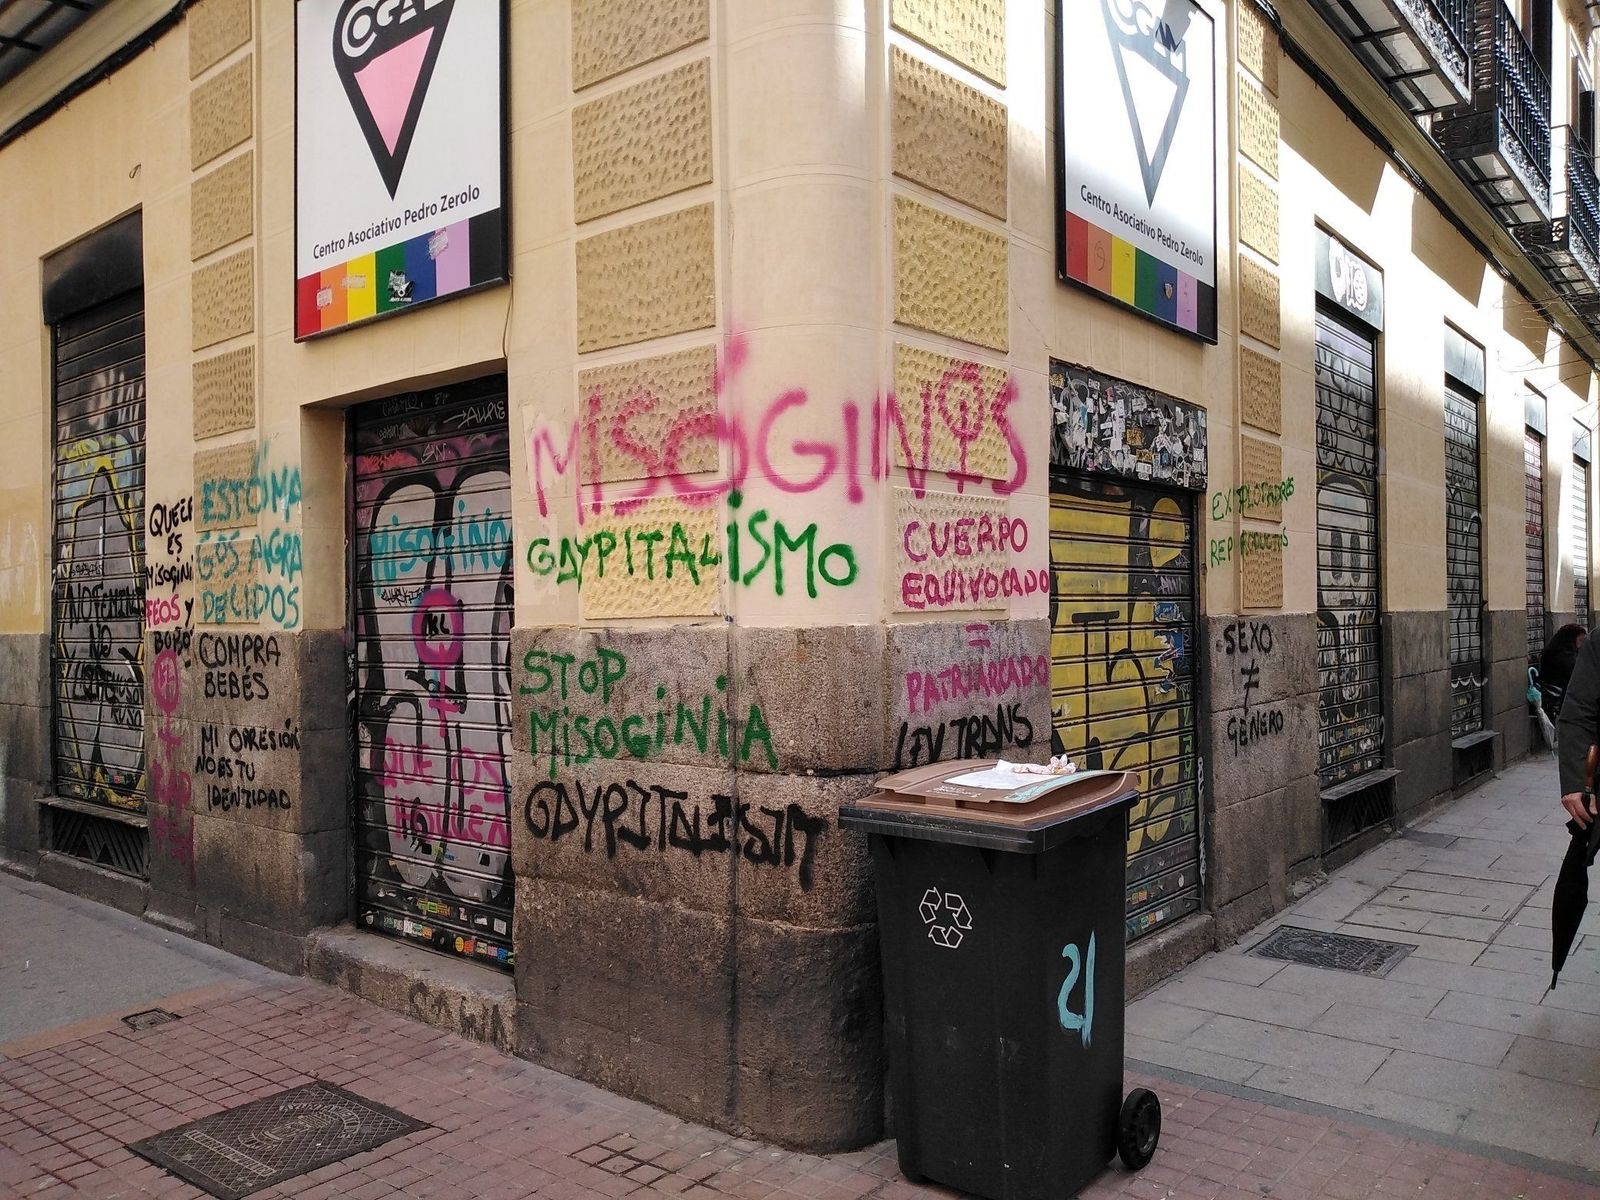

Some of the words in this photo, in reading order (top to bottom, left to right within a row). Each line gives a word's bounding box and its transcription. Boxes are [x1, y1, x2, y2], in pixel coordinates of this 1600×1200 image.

[313, 235, 345, 259] Centro
[347, 216, 401, 247] Asociativo
[404, 203, 437, 226] Pedro
[440, 184, 480, 213] Zerolo
[1080, 184, 1112, 215] Centro
[1113, 203, 1156, 239] Asociativo
[1157, 227, 1179, 253] Pedro
[1180, 241, 1204, 266] Zerolo
[167, 532, 182, 555] ES
[904, 514, 1028, 562] CUERPO
[202, 583, 301, 629] DECIDOS
[902, 567, 1049, 609] EQUIVOCADO
[146, 594, 180, 629] FEOS
[154, 626, 194, 656] BOBO
[199, 635, 281, 668] COMPRA
[1224, 620, 1273, 655] SEXO
[205, 665, 269, 701] BEBÉS
[519, 648, 627, 704] STOP
[905, 655, 1050, 714] PATRIARCADO
[202, 725, 218, 754] MI
[950, 703, 1033, 759] TRANS
[196, 755, 216, 774] NO
[218, 757, 234, 778] ES
[235, 759, 256, 781] TU
[208, 784, 292, 812] IDENTIDAD
